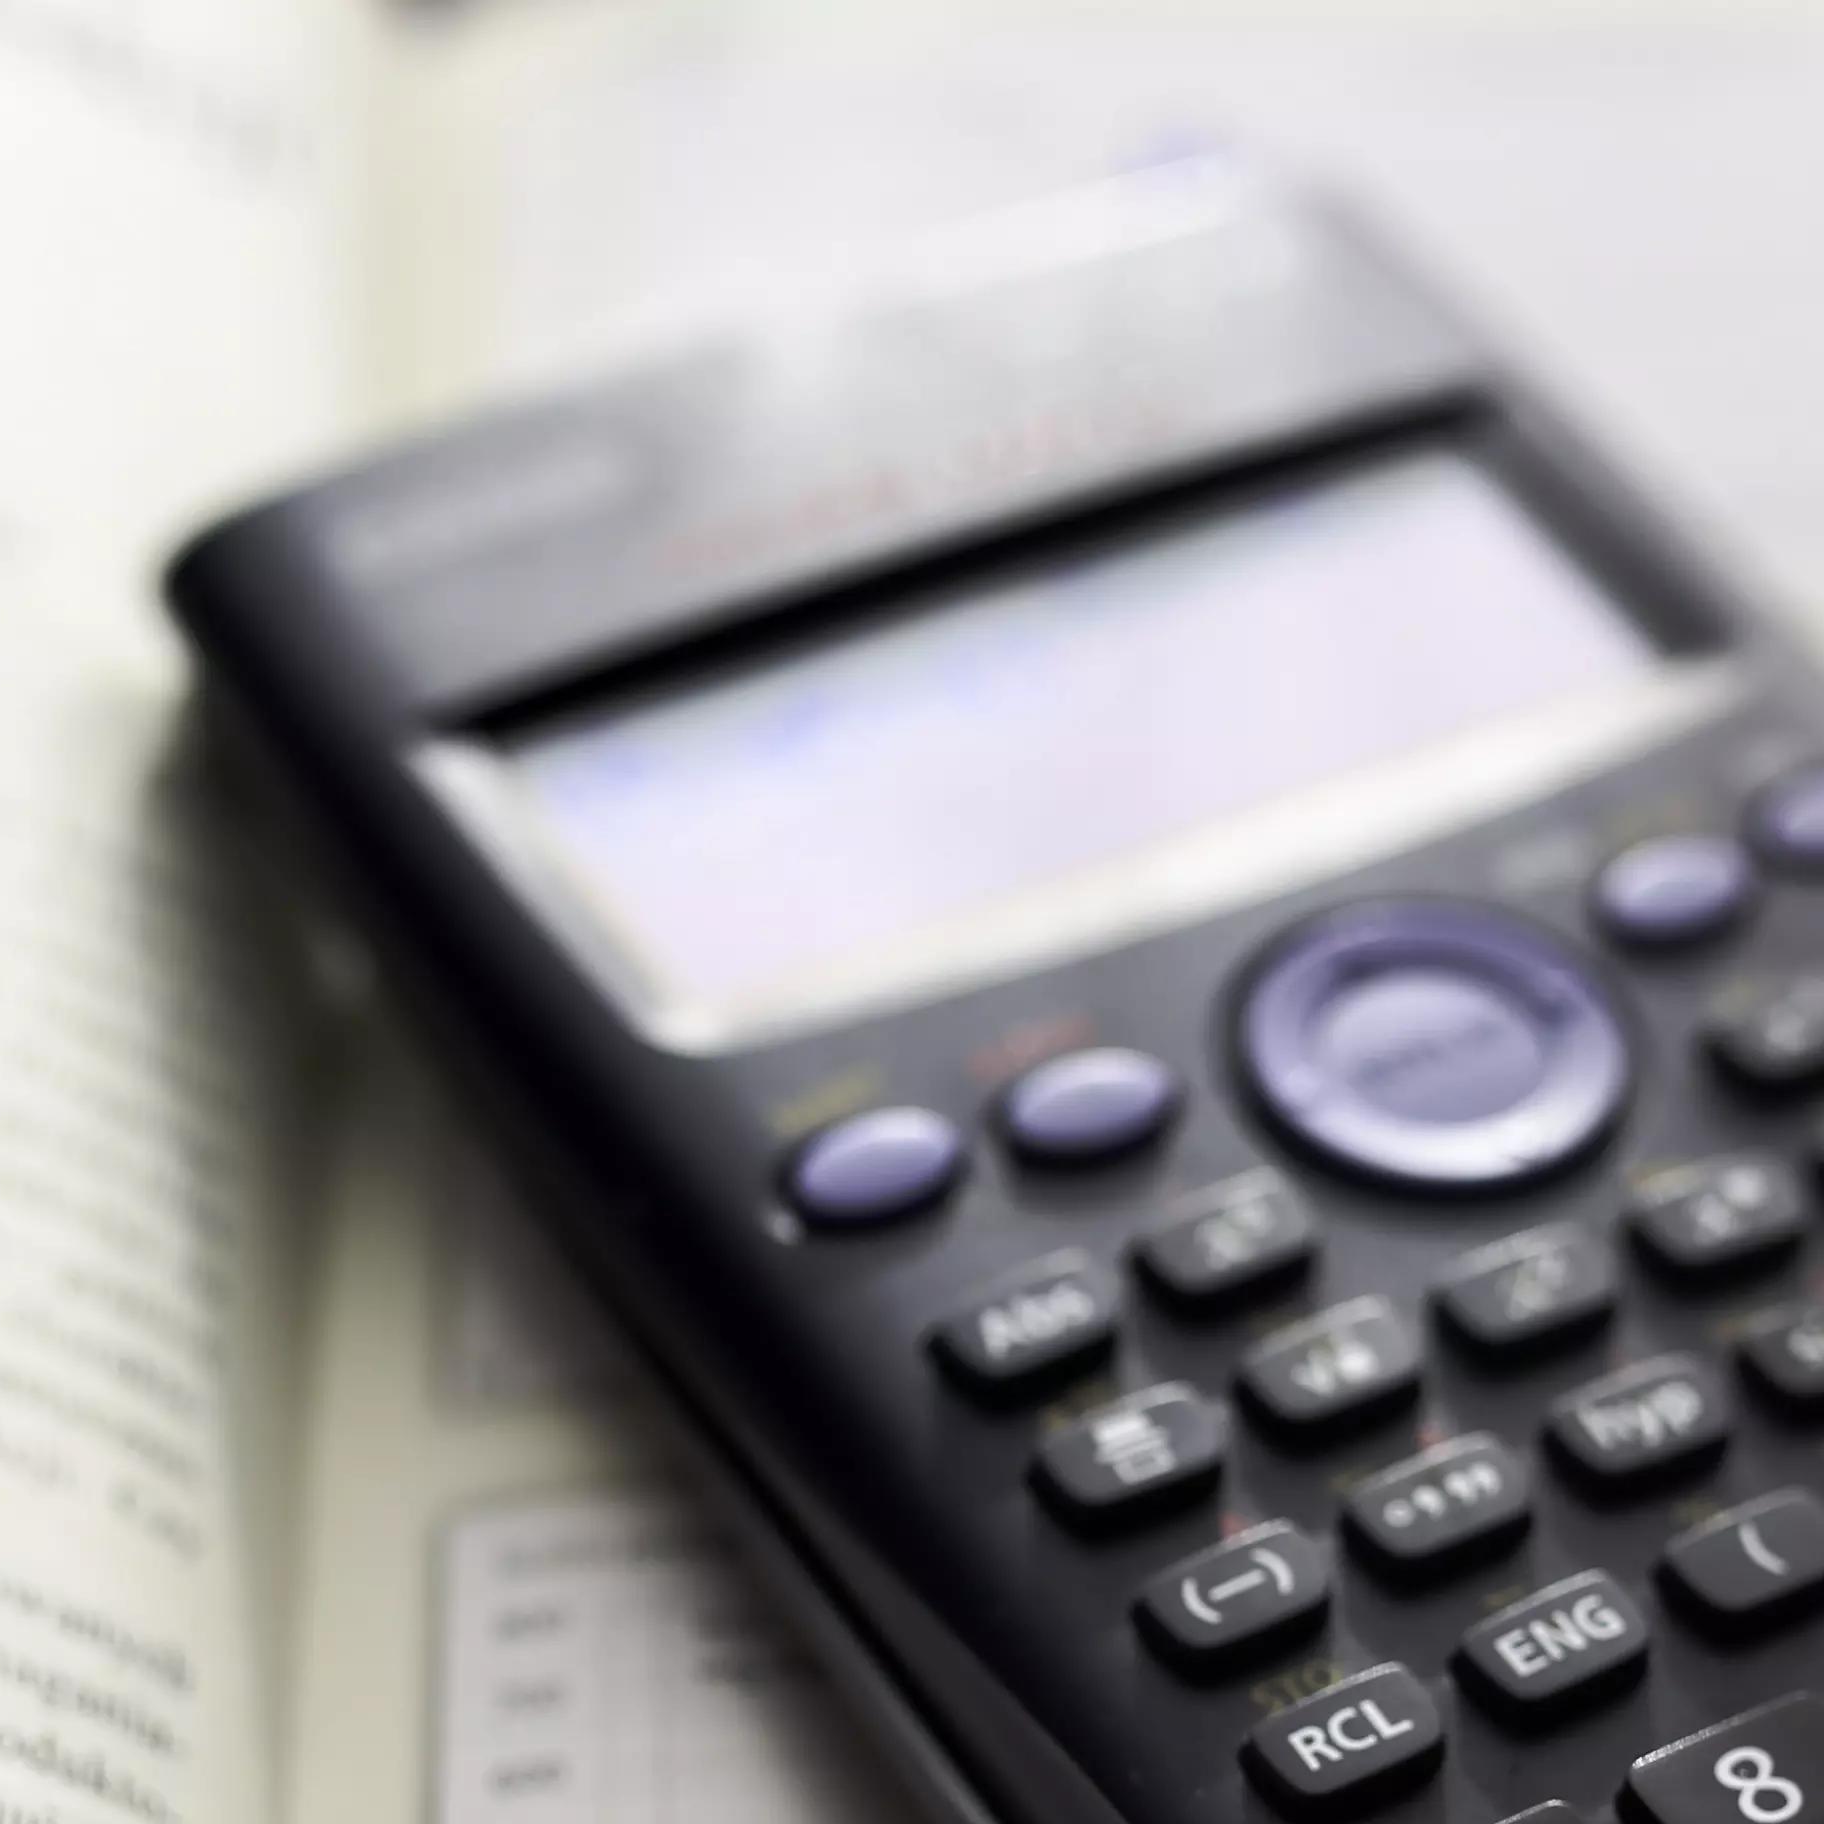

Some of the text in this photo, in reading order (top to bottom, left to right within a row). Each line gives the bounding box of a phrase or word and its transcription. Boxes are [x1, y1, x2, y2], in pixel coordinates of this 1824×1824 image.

[1494, 1593, 1626, 1678] ENG
[1287, 1695, 1416, 1774] RCL
[1713, 1746, 1804, 1824] 8
